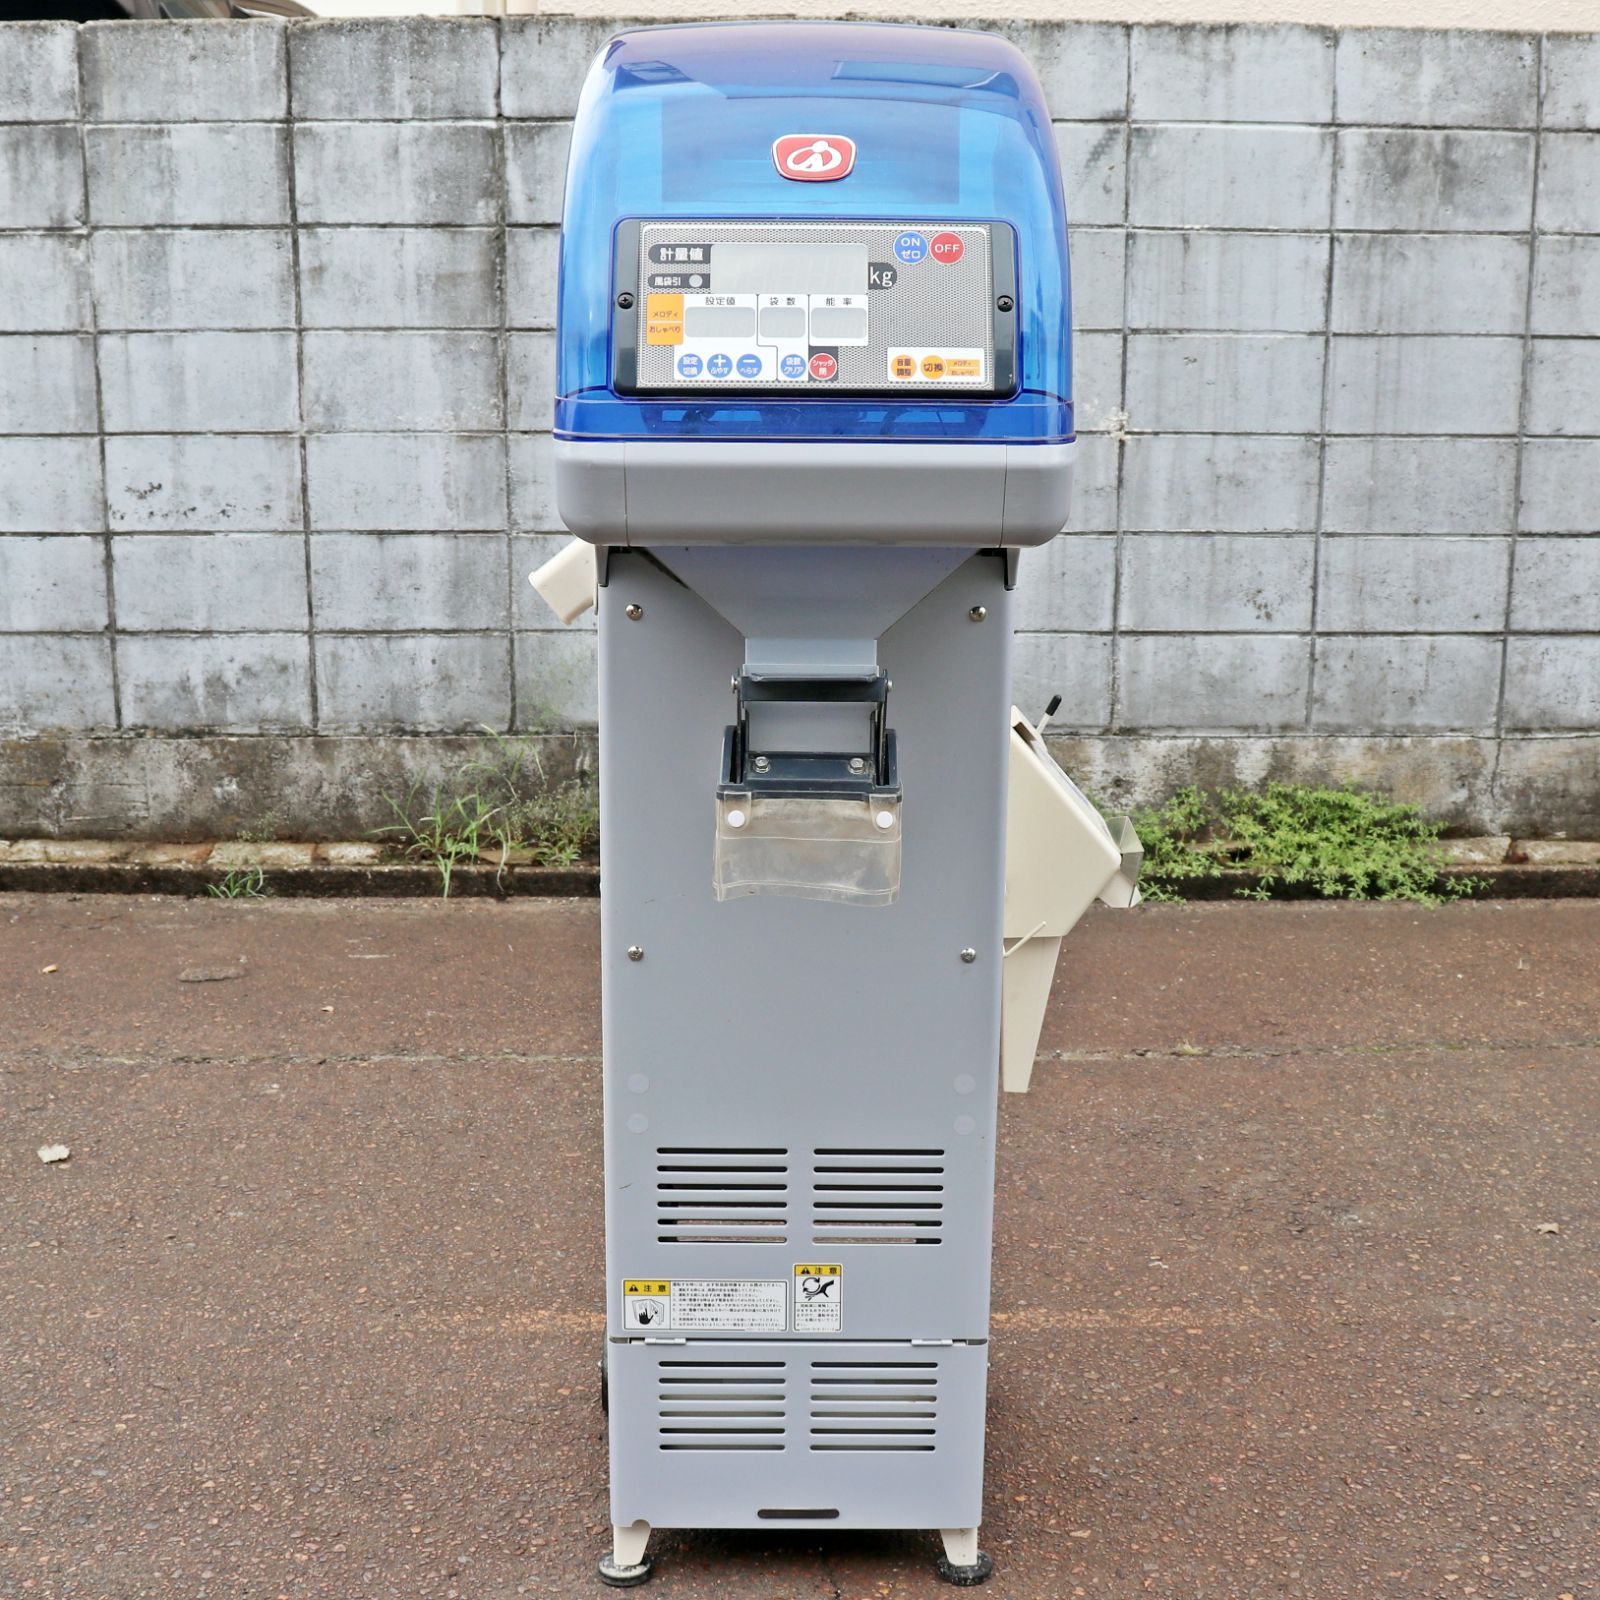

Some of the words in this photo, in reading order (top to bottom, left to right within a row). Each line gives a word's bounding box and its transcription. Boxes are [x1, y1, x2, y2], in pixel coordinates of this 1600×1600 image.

[901, 237, 920, 247] ON
[934, 243, 960, 253] OFF
[901, 250, 920, 259] ゼロ
[869, 266, 893, 287] kg
[705, 296, 736, 306] 設定値
[649, 325, 681, 333] おしゃべり
[783, 366, 804, 375] クリア
[924, 362, 943, 373] 切換
[814, 1266, 838, 1275] 注意
[643, 1284, 667, 1293] 注意
